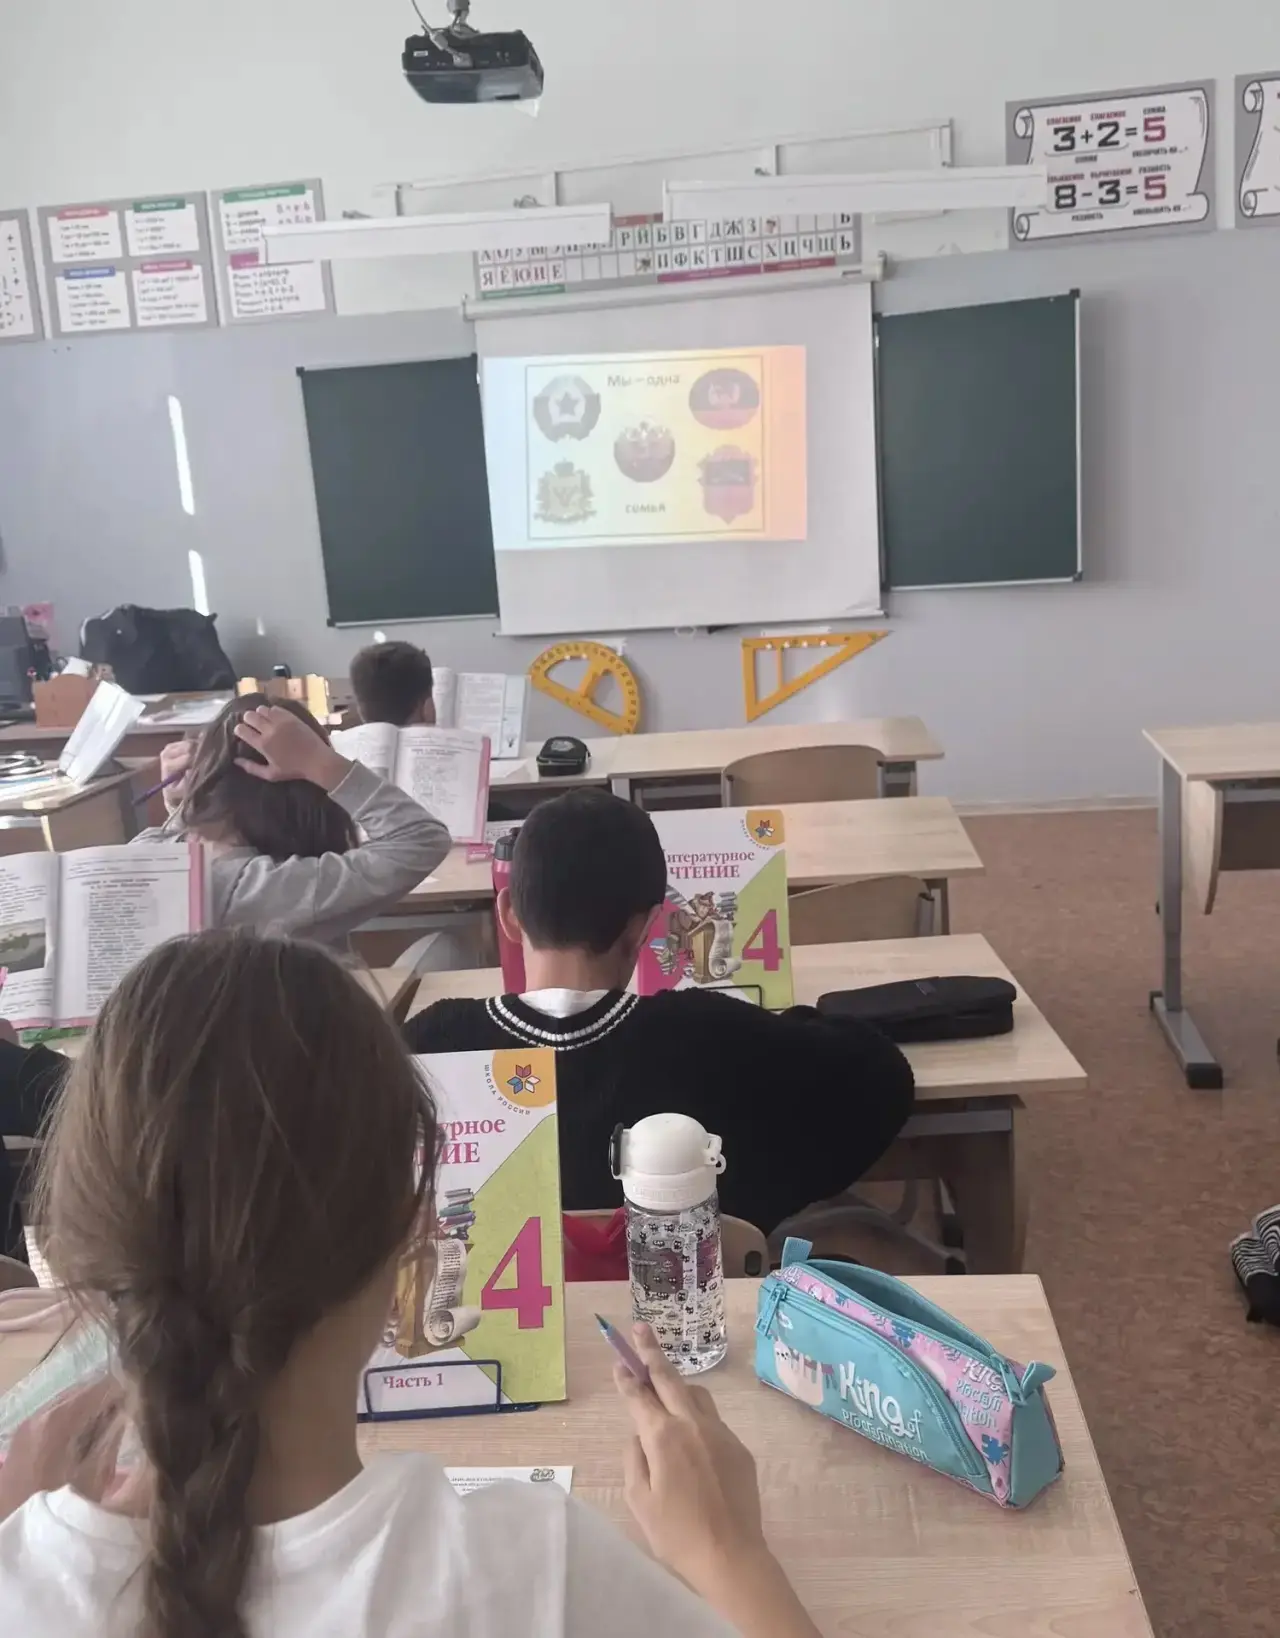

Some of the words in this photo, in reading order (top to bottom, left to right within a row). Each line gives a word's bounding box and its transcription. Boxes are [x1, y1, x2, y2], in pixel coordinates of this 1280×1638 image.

[667, 851, 755, 866] итературное
[670, 865, 740, 879] ЧТЕНИЕ
[741, 908, 784, 971] 4
[481, 1216, 553, 1329] 4
[384, 1376, 432, 1388] Часть
[437, 1373, 444, 1386] 1
[839, 1360, 914, 1438] King
